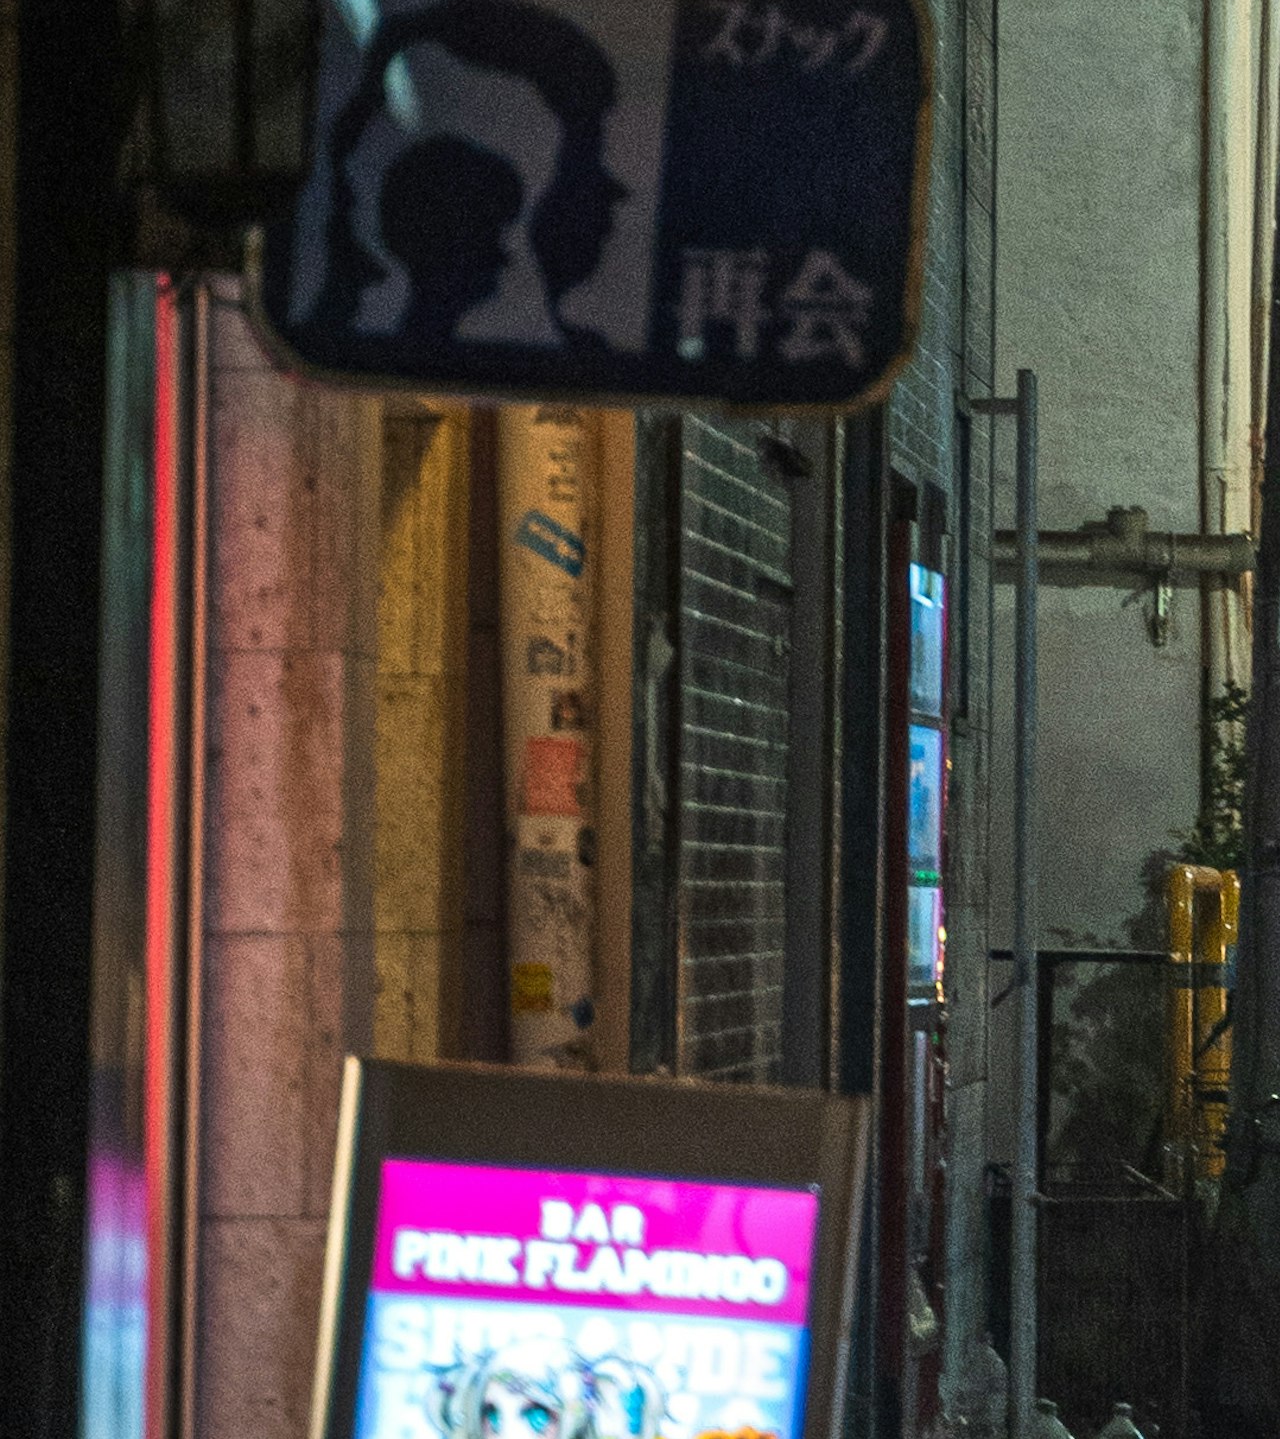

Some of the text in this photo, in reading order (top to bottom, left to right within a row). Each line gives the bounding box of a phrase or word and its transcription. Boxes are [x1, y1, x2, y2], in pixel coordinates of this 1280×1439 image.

[672, 248, 876, 366] 再会
[540, 1199, 645, 1247] BAR
[393, 1229, 788, 1305] PINK FLAMINGO
